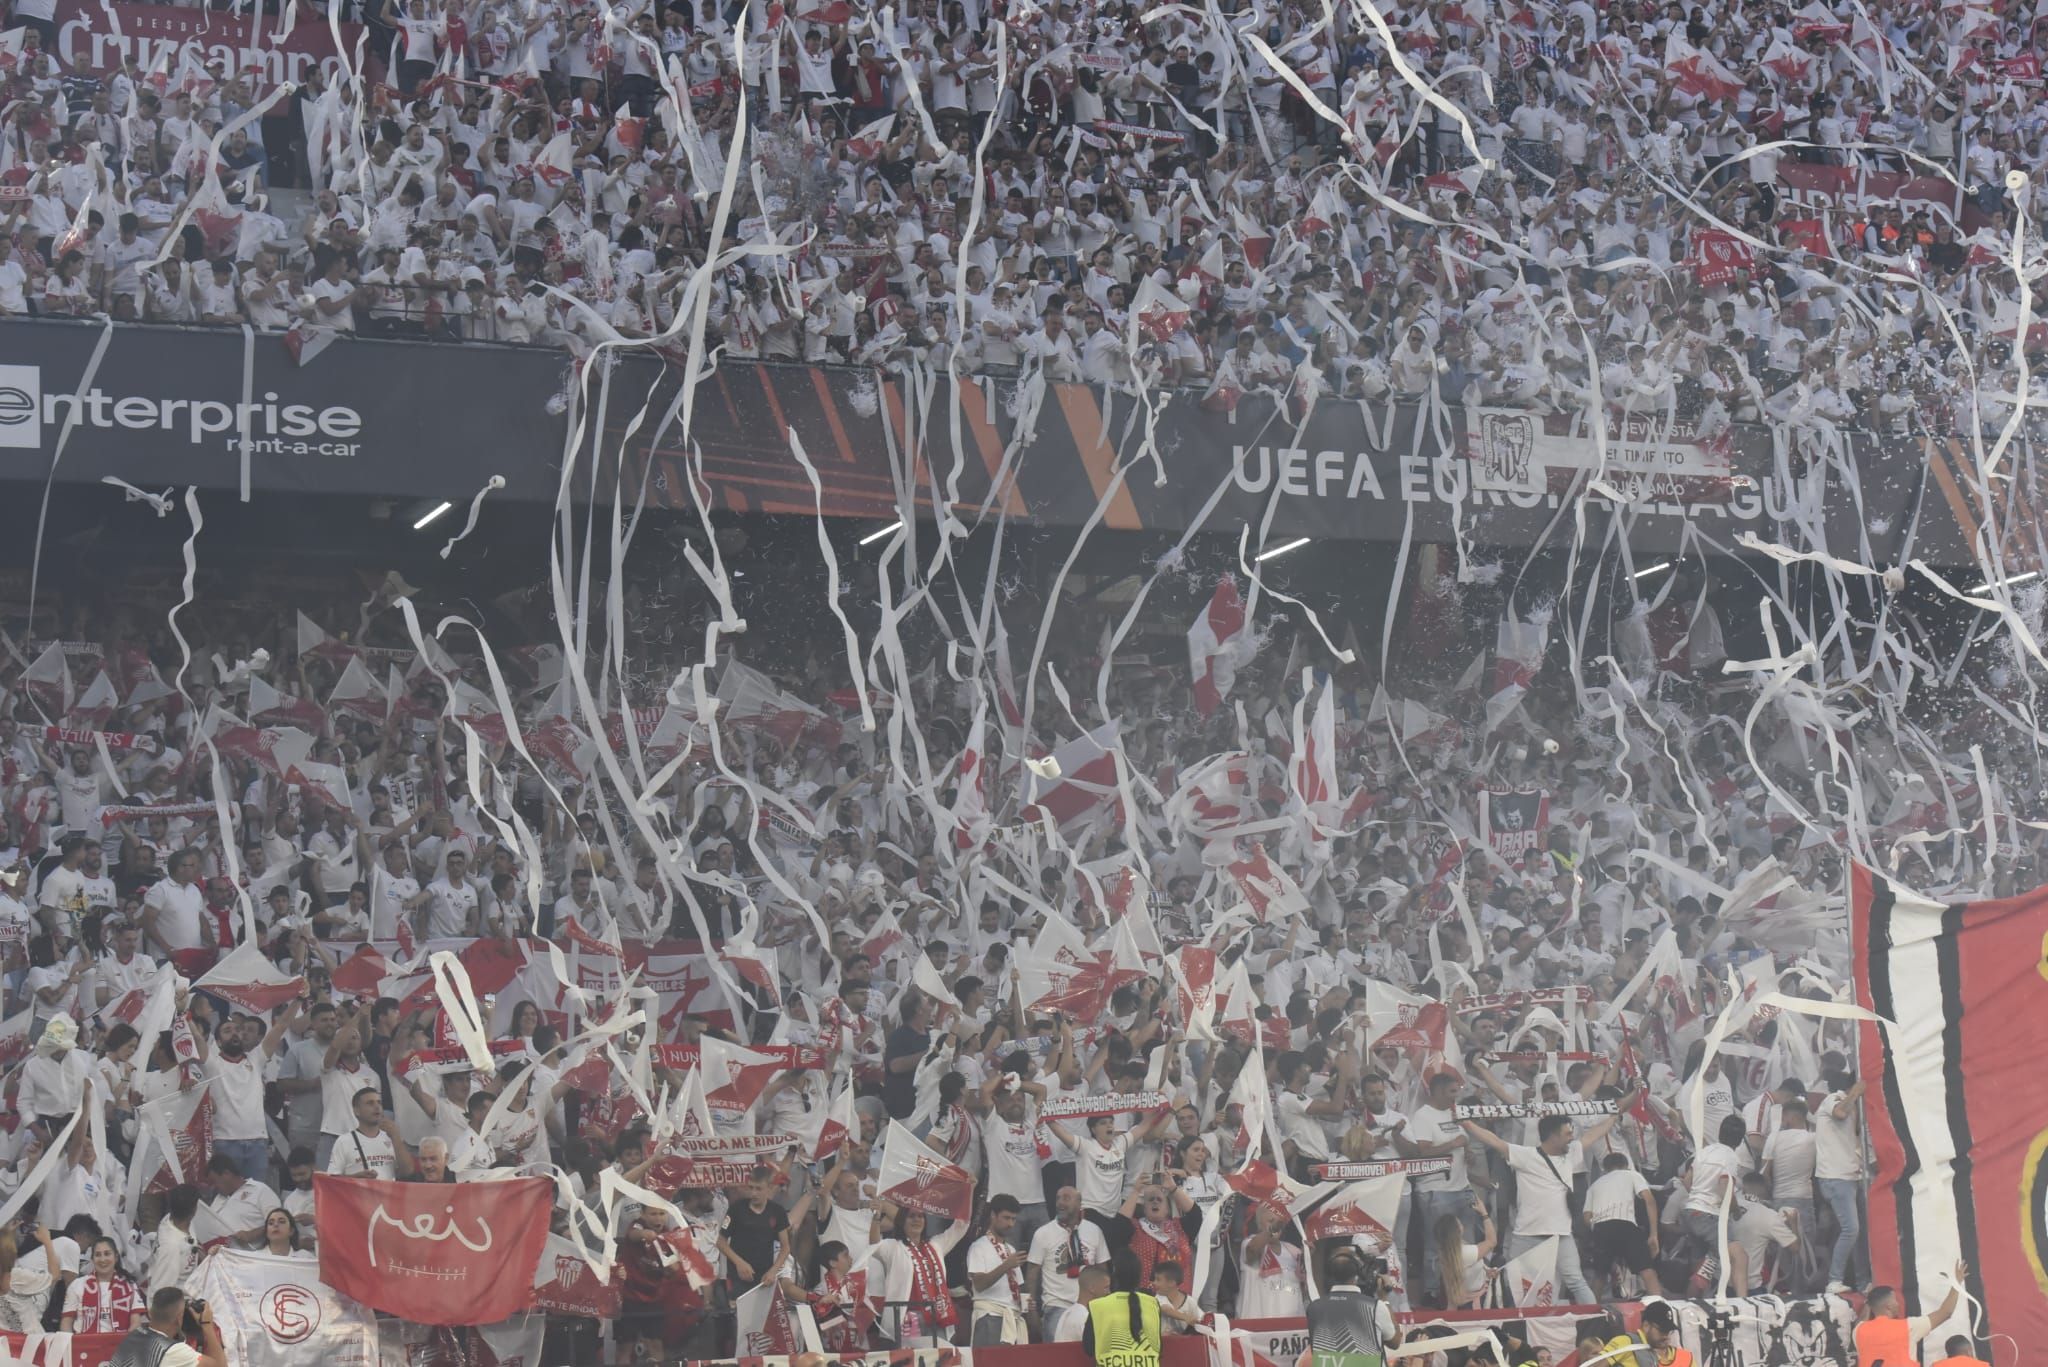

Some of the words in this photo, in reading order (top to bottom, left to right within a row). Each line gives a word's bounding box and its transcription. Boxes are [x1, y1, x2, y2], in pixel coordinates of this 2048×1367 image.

[137, 16, 200, 33] DESDE
[227, 437, 361, 457] rent-a-car
[1233, 446, 1385, 500] UEFA
[682, 1139, 728, 1152] NUNCA
[732, 1138, 751, 1150] ME
[355, 1154, 394, 1163] MRATHON
[1327, 1165, 1339, 1178] DE
[1340, 1164, 1386, 1177] EINDHOVEN
[1412, 1164, 1421, 1173] LA
[923, 1203, 950, 1216] RINDAS
[535, 1299, 557, 1309] UNCA
[558, 1301, 568, 1311] TE
[568, 1303, 600, 1316] RINDAS
